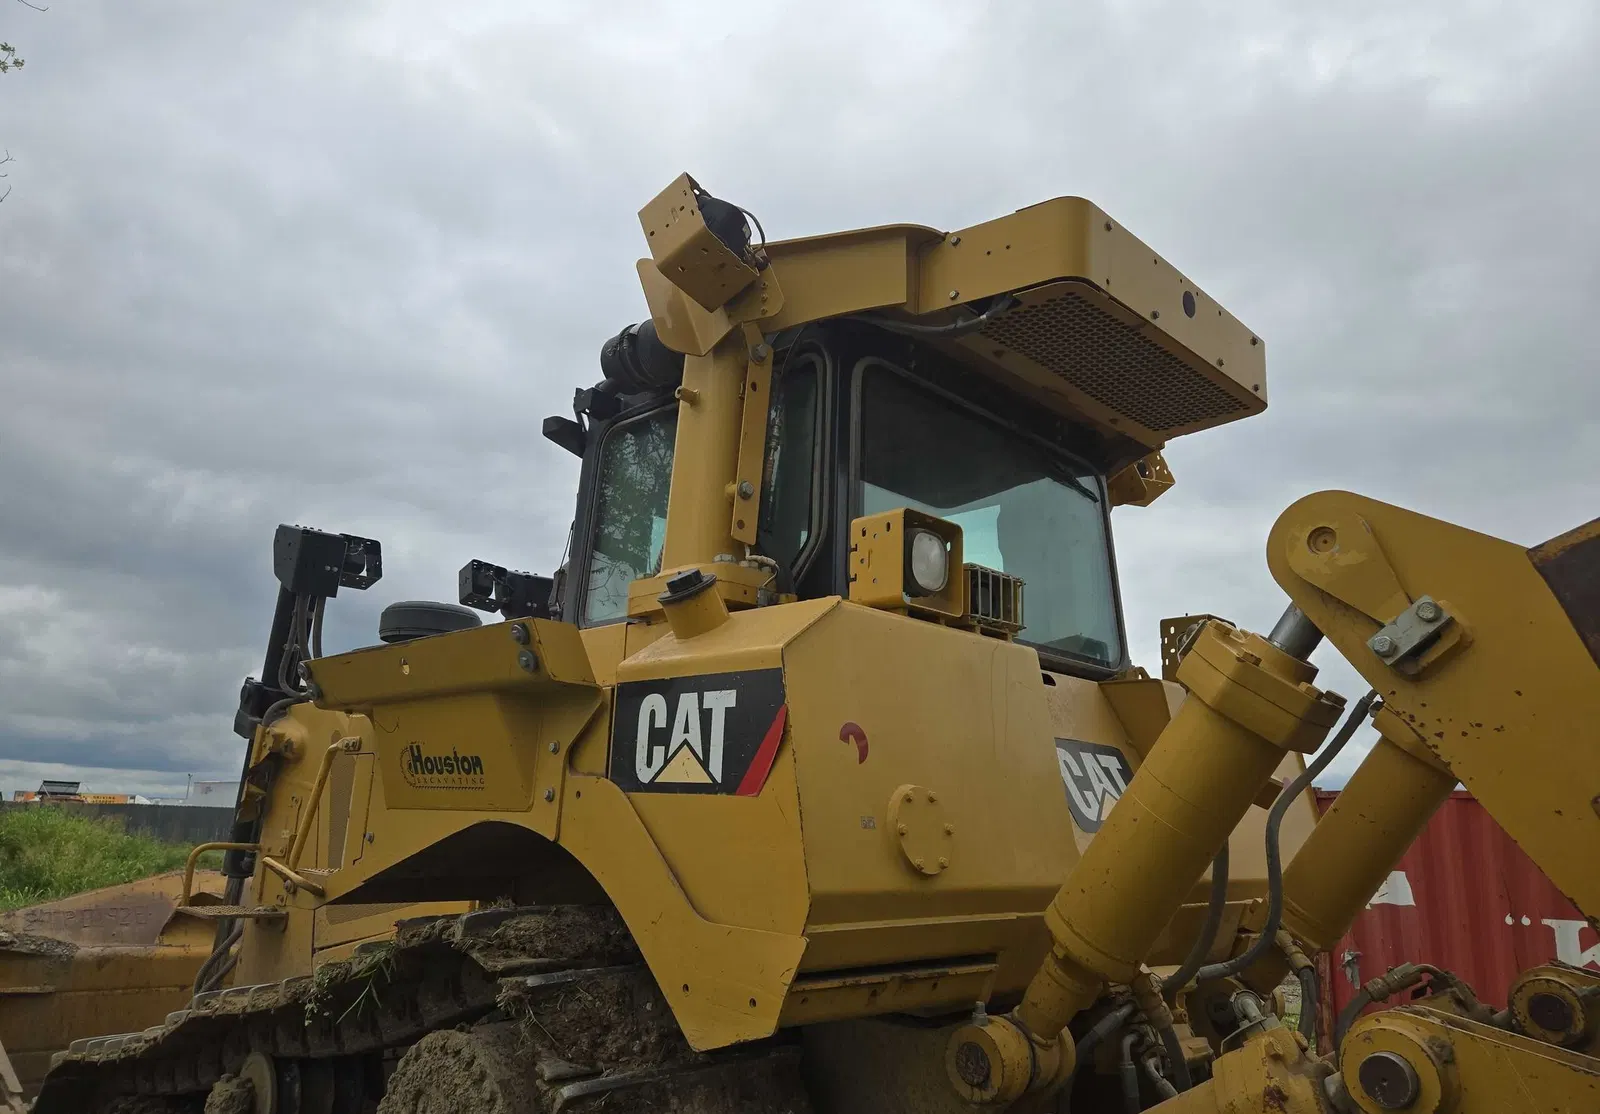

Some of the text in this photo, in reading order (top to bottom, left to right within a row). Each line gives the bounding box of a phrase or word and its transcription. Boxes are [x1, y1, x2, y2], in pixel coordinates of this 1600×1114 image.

[408, 744, 484, 775] Houston
[636, 689, 737, 784] CAT
[415, 777, 485, 785] EXCAVATING
[1056, 747, 1128, 822] CAT
